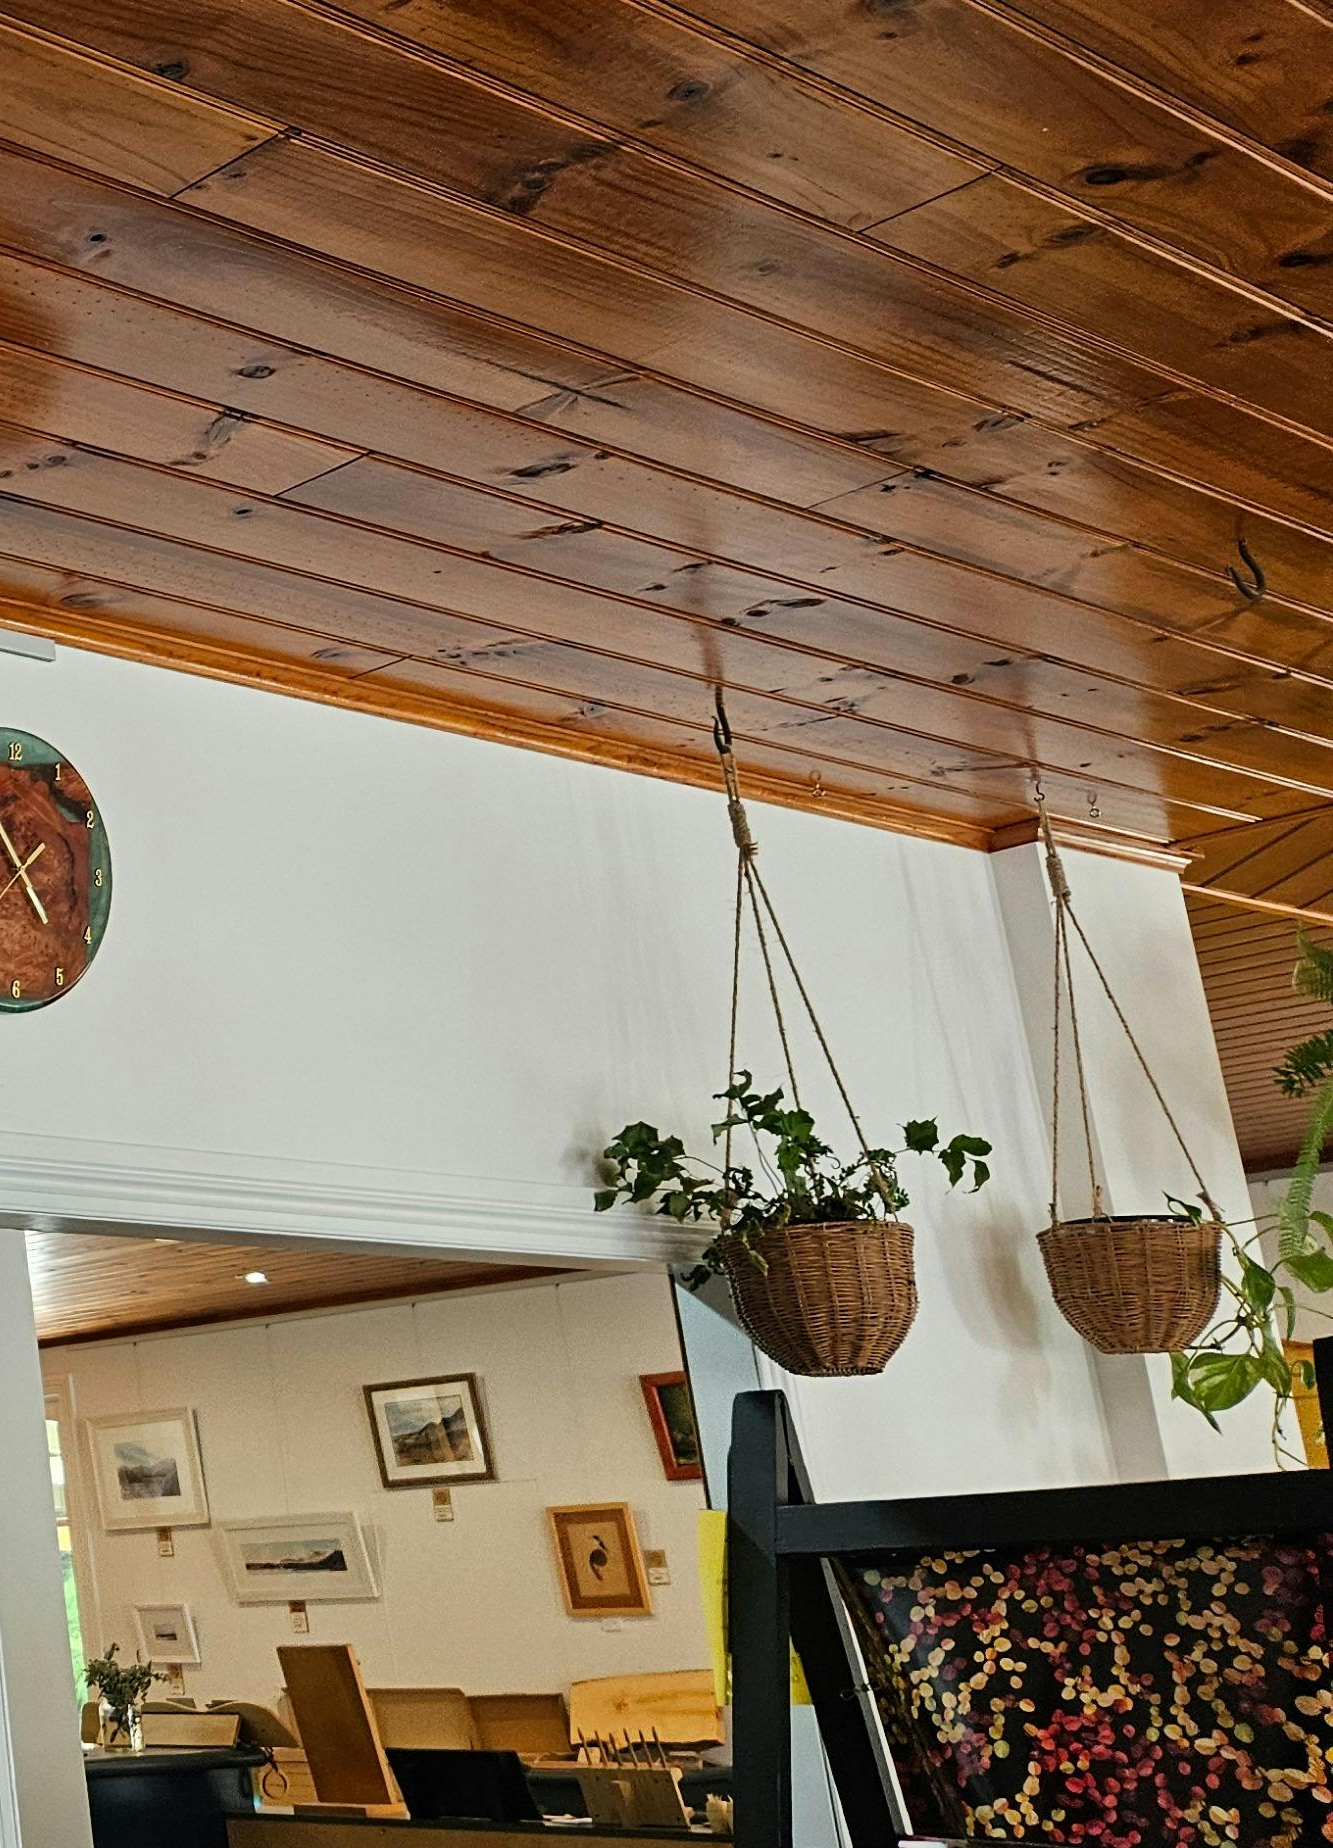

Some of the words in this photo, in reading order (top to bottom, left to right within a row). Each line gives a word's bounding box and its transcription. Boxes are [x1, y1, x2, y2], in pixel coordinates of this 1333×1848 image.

[9, 742, 23, 761] 12
[54, 764, 62, 781] 1
[86, 811, 94, 828] 2
[95, 869, 103, 887] 3
[83, 926, 91, 945] 4
[56, 968, 64, 986] 5
[12, 981, 20, 998] 6
